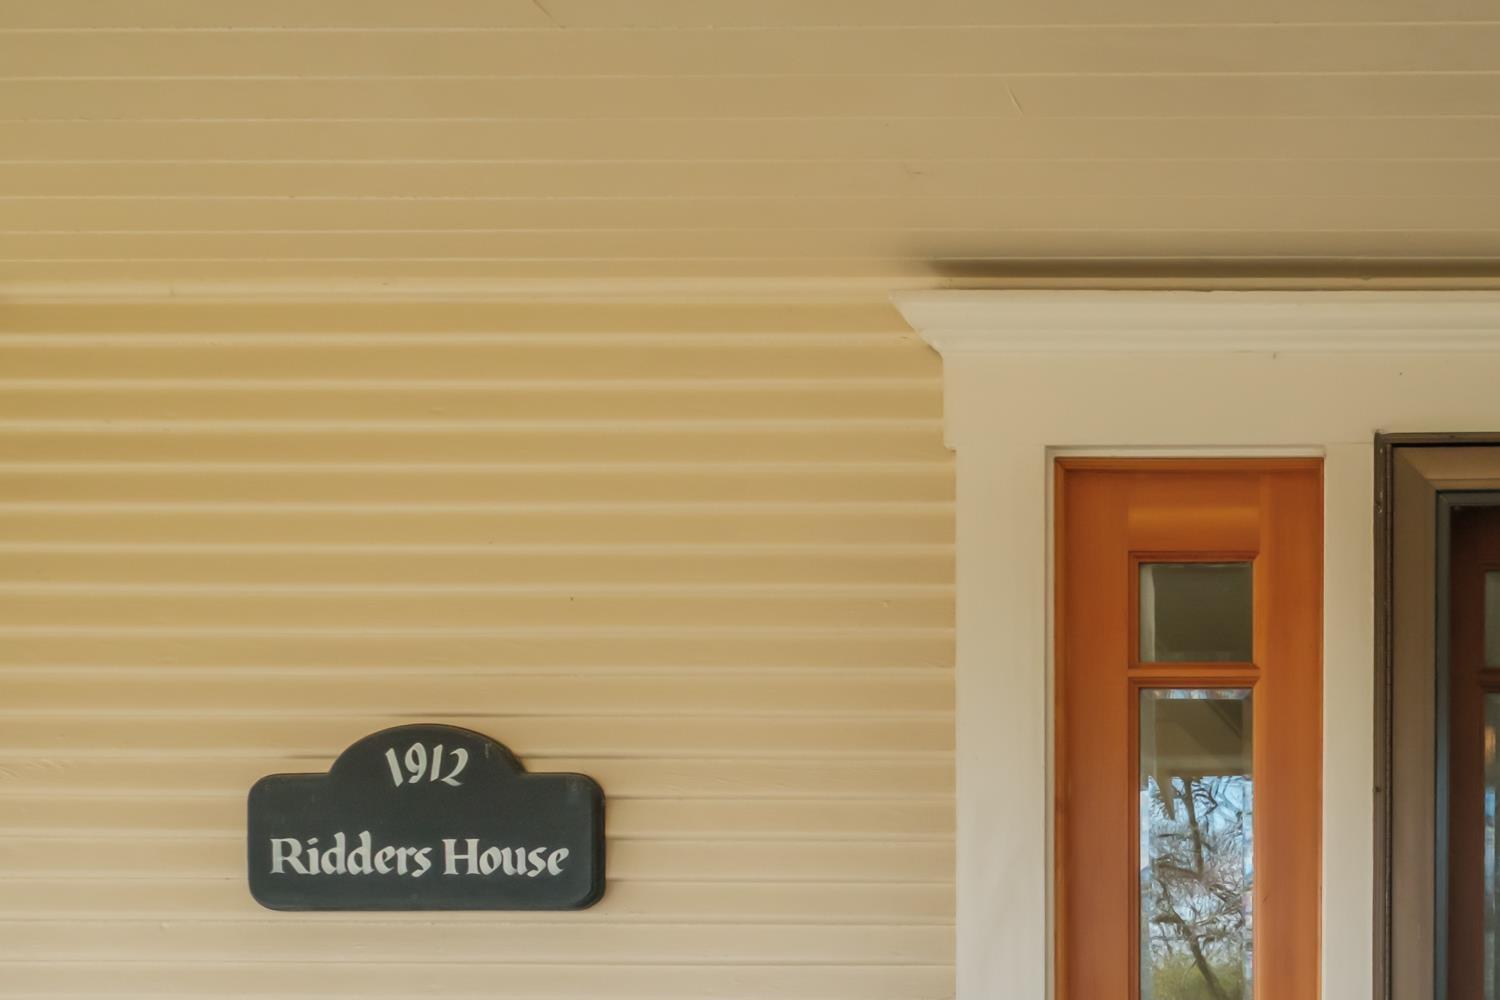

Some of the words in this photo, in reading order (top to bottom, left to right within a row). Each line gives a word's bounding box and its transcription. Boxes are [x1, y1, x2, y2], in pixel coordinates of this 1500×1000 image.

[385, 742, 469, 787] 1912
[269, 830, 432, 878] Ridders
[441, 837, 570, 877] House
